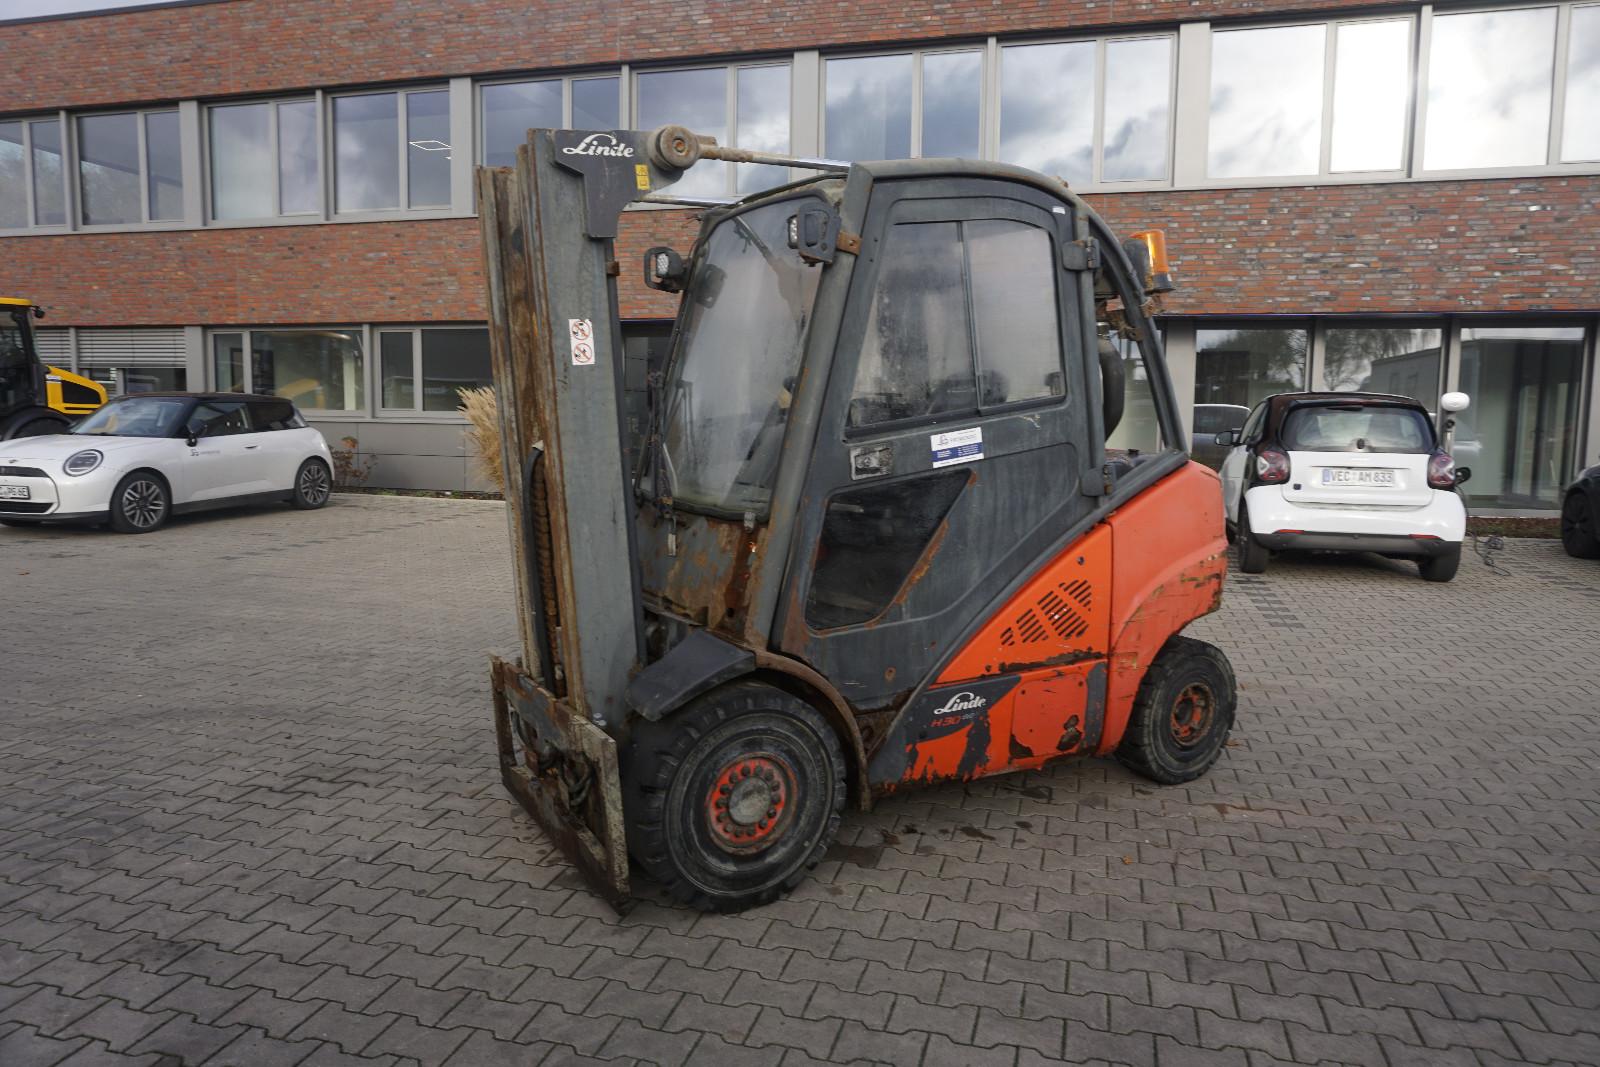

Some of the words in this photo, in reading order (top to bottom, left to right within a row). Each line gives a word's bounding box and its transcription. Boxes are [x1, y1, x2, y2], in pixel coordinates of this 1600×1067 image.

[562, 133, 634, 157] Linde
[1331, 471, 1350, 482] VEC
[1358, 472, 1372, 482] AM
[1373, 472, 1393, 483] 833
[933, 691, 987, 715] Linde
